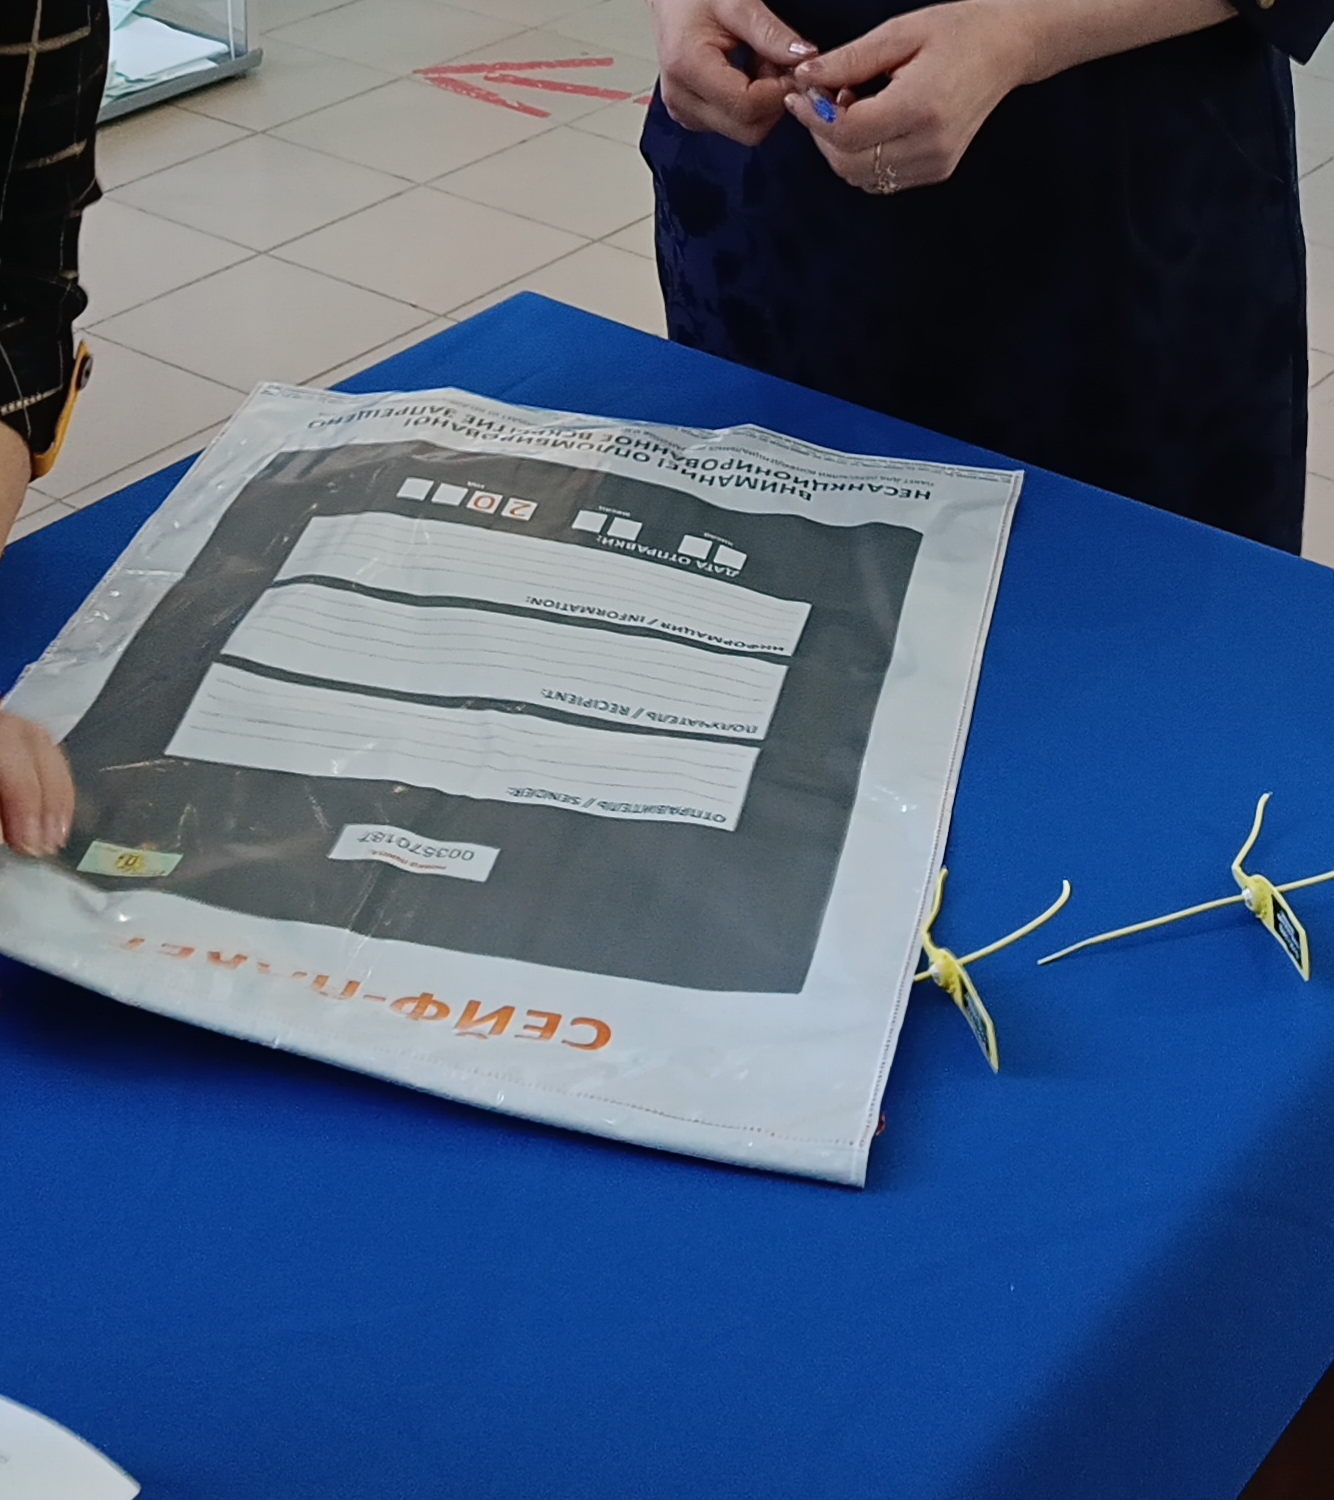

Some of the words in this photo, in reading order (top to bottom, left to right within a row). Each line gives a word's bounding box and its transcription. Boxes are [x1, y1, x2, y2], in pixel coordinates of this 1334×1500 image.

[308, 405, 454, 431] ЗАПРЕЩЕНО
[403, 416, 651, 460] ОПЛОМБИРОВАНО!
[656, 456, 813, 502] ВНИМАНИЕ!
[596, 534, 693, 566] ОТПРАВКИ:
[695, 560, 741, 578] ДАТА
[525, 595, 646, 624] INFORMATION:
[660, 621, 785, 652] ИНФОРМАЦИЯ
[540, 687, 631, 717] RECIPIENT:
[646, 711, 759, 735] ПОЛУЧАТЕЛЬ
[507, 785, 583, 806] SENDER:
[596, 800, 728, 824] ОТПРАВИТЕЛЬ
